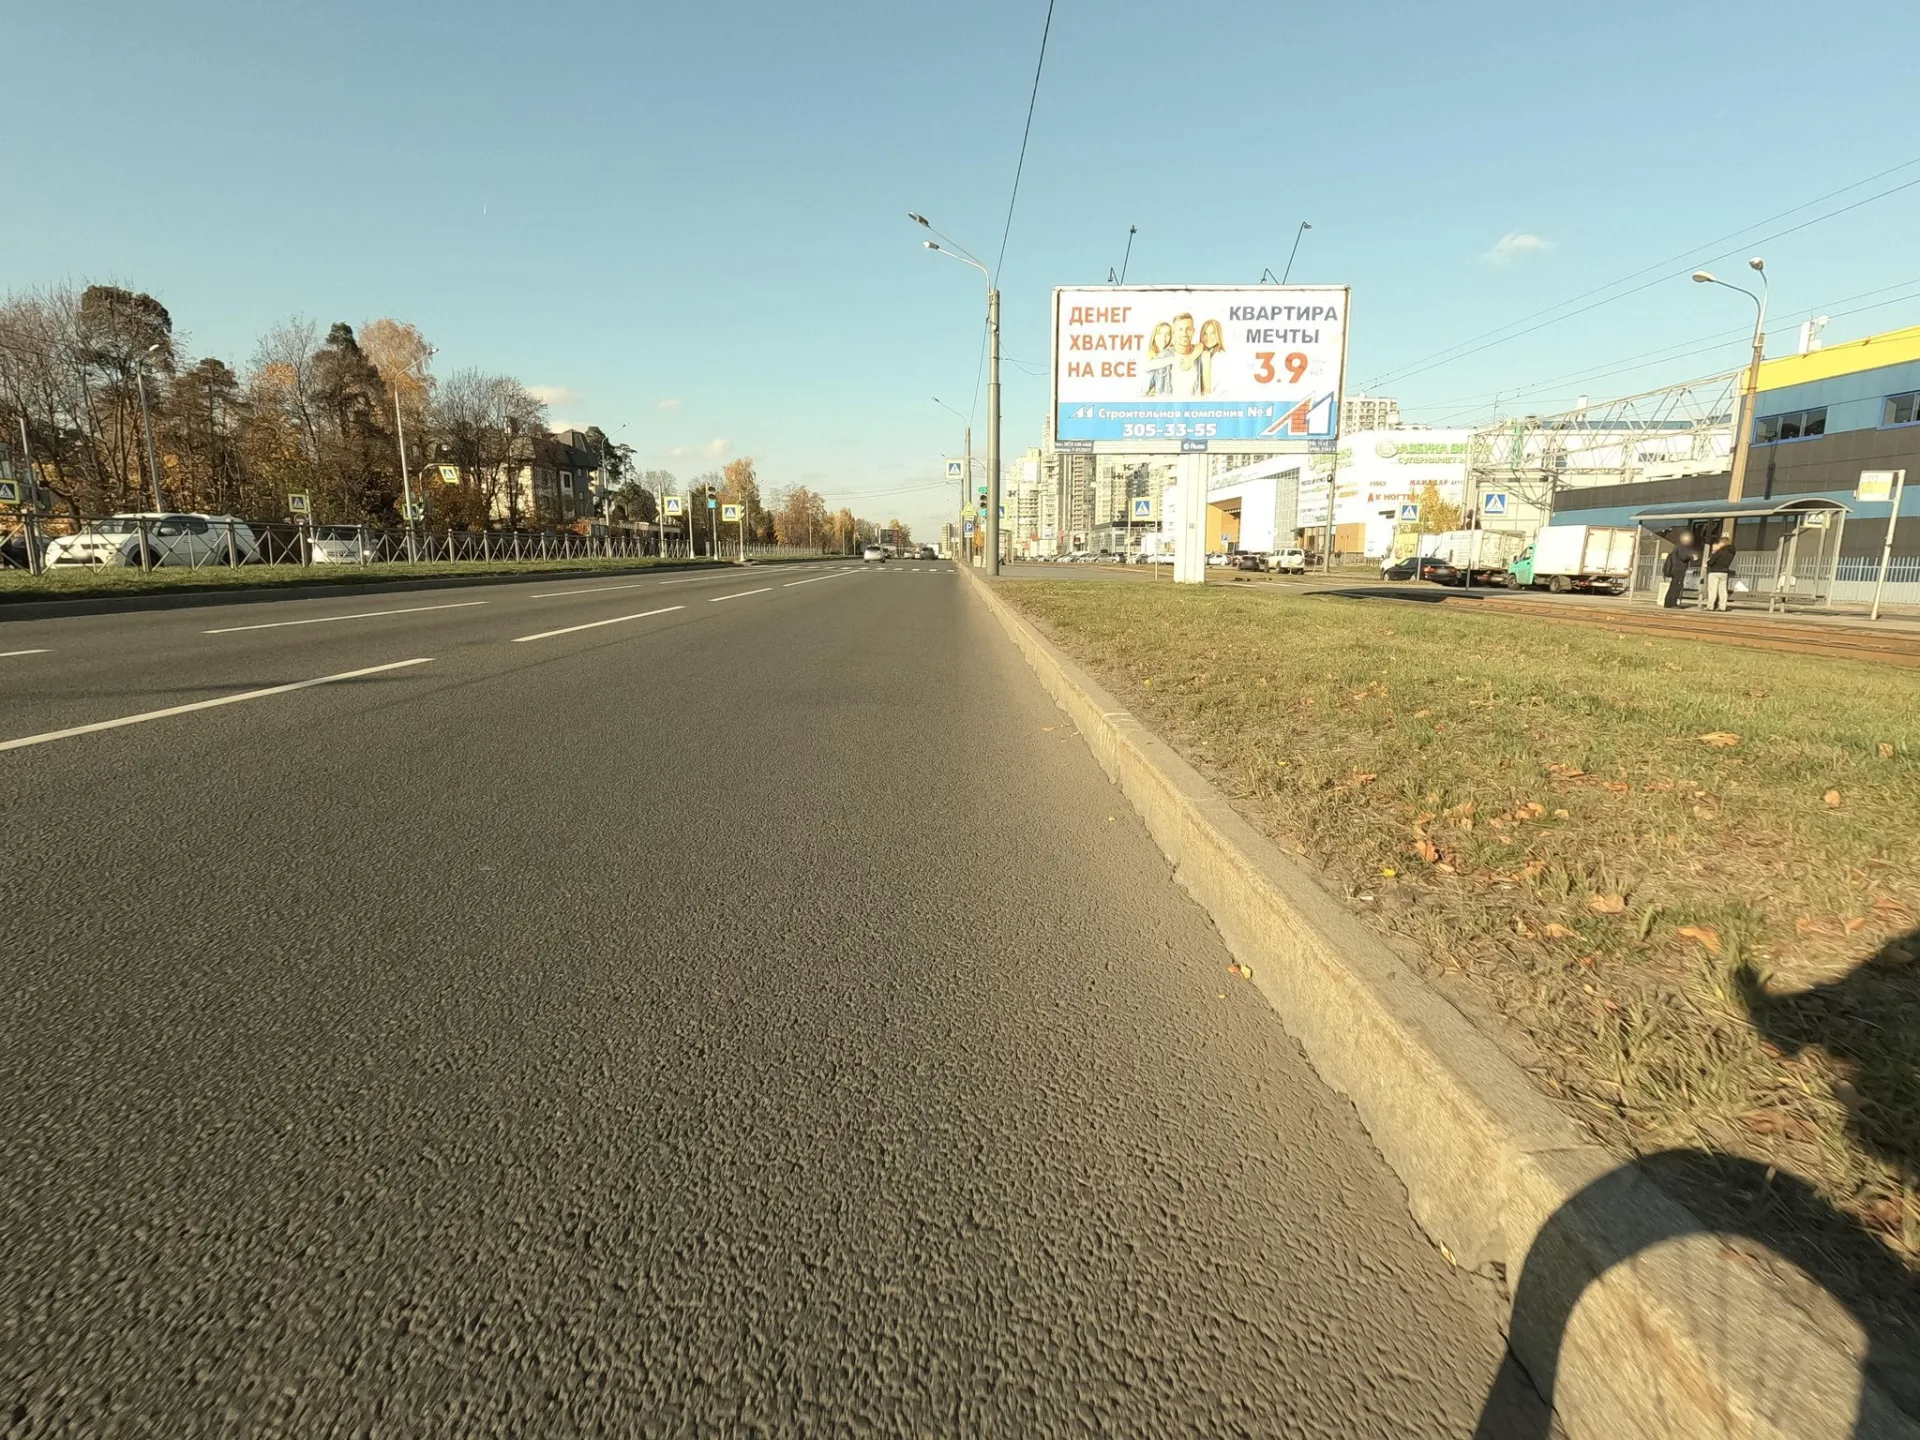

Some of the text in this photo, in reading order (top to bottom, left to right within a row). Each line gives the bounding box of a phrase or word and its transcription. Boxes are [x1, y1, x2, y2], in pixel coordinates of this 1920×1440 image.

[1069, 306, 1132, 326] ДЕНЕГ
[1229, 306, 1338, 322] КВАРТИРА
[1069, 334, 1144, 351] ХВАТИТ
[1246, 328, 1319, 344] МЕЧТЫ
[1068, 361, 1094, 378] НА
[1253, 352, 1309, 384] 3.9
[1098, 408, 1181, 420] Строительная
[1184, 410, 1244, 418] компания
[1123, 423, 1217, 437] 305-33-55
